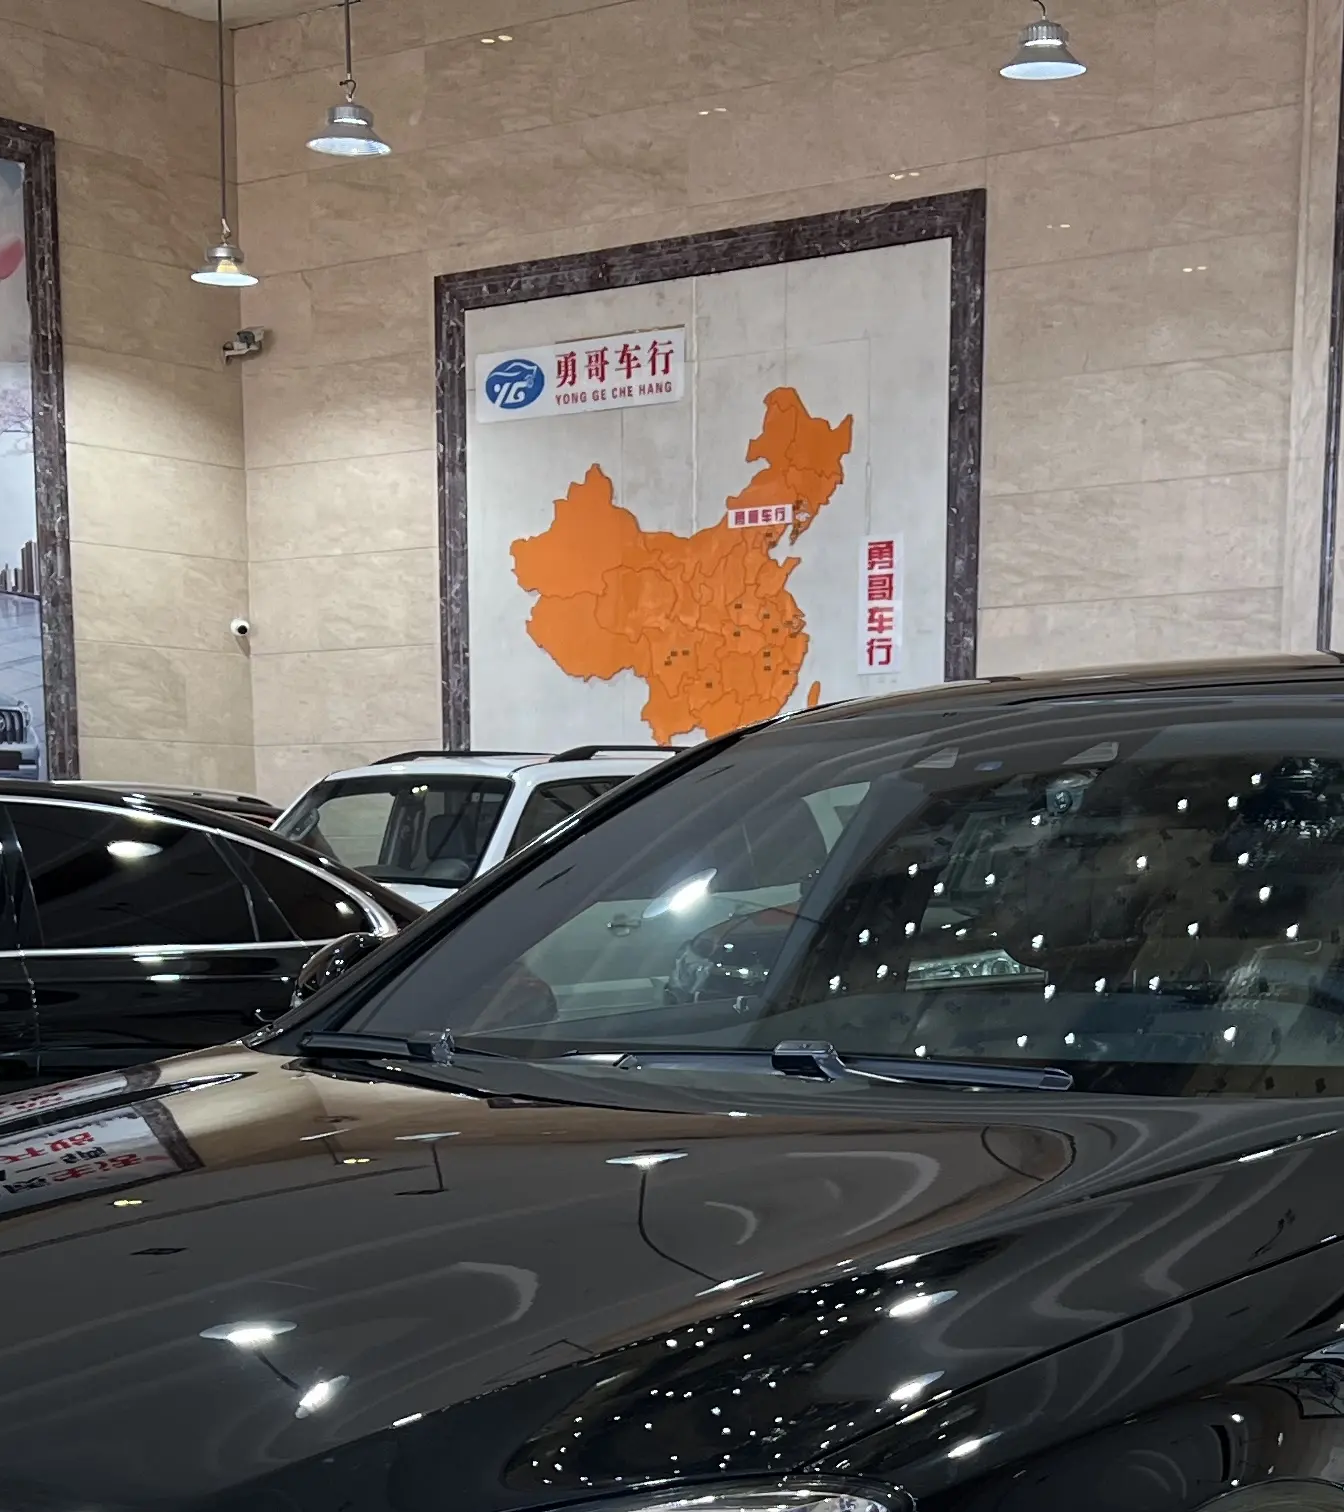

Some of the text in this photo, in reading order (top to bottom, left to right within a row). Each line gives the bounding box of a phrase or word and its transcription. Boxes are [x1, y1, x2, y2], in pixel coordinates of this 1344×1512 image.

[555, 339, 675, 389] 勇哥车行
[555, 381, 673, 406] YONG GE CHE HANG
[866, 539, 895, 667] 勇哥车行
